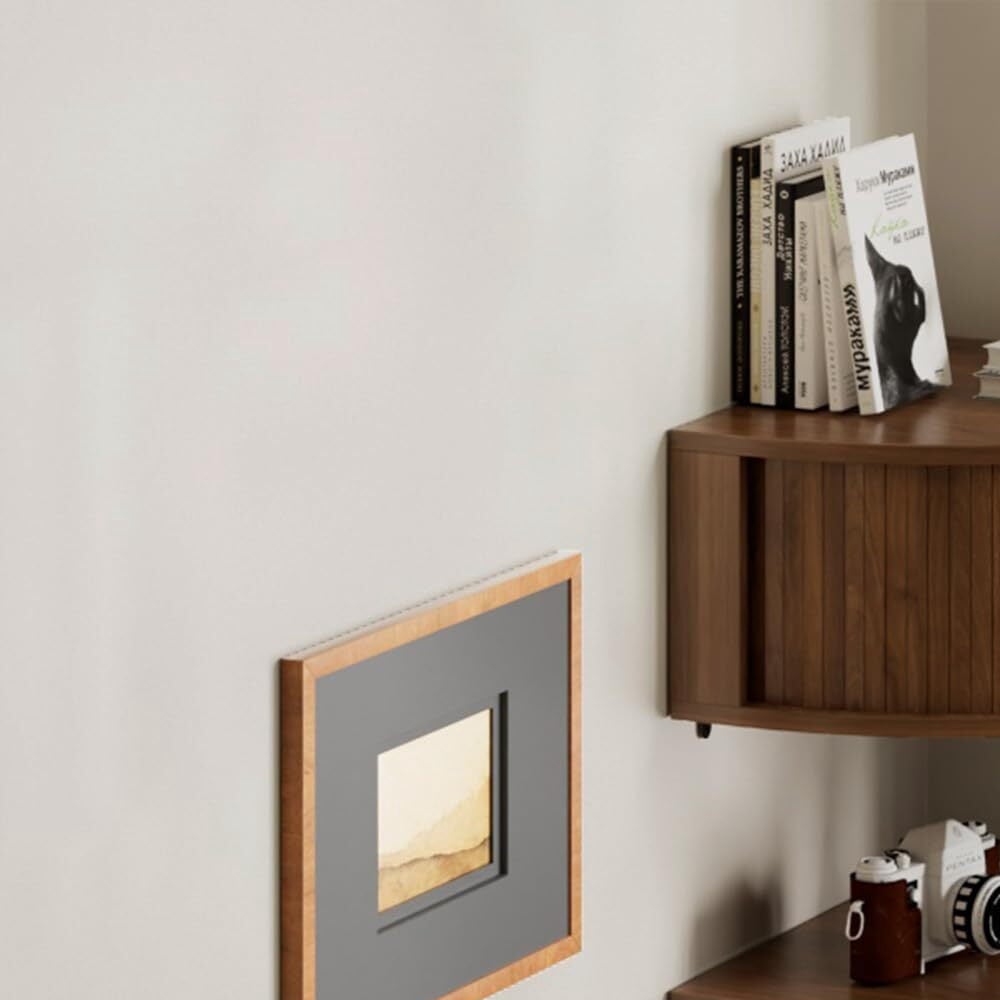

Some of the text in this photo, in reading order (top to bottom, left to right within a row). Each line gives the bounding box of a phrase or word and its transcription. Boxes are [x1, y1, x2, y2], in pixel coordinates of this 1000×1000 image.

[736, 165, 744, 216] BROTHERS
[762, 168, 773, 247] ЗАХА ХАДИД
[736, 218, 744, 277] KARAMAZOV
